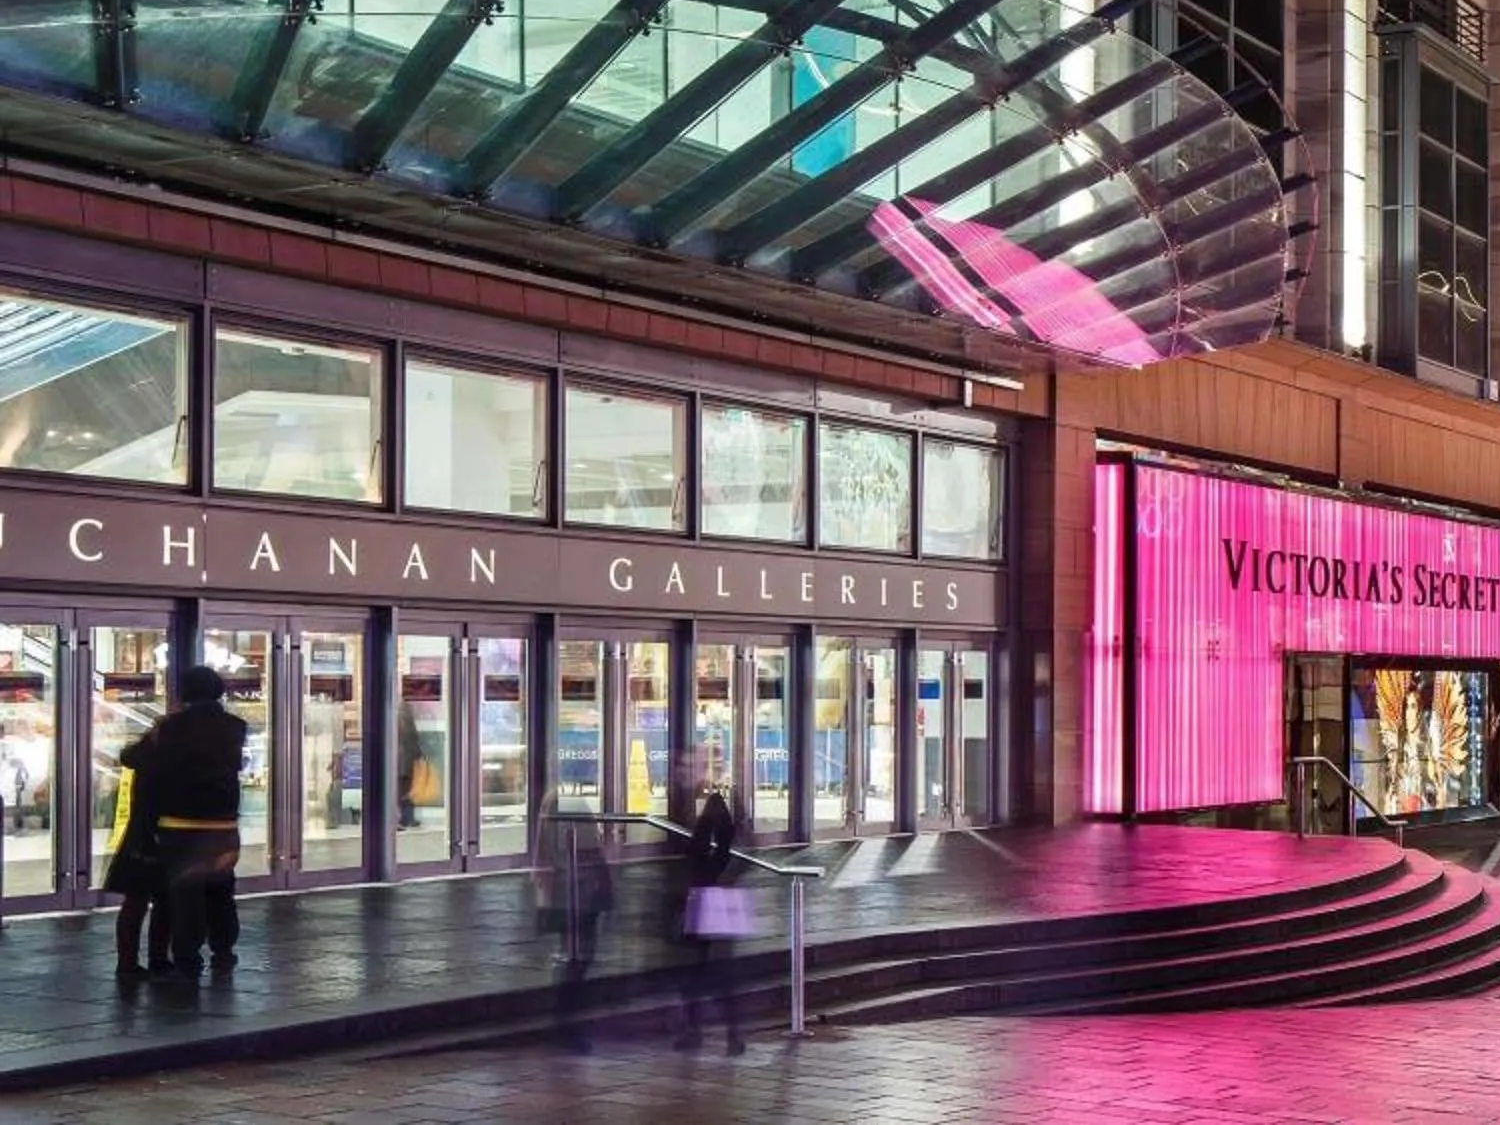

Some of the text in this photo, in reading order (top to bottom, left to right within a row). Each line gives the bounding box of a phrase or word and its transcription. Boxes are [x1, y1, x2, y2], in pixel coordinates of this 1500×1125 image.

[609, 557, 958, 611] GALLERIES
[1222, 538, 1500, 613] VICTORIA'S SECRET
